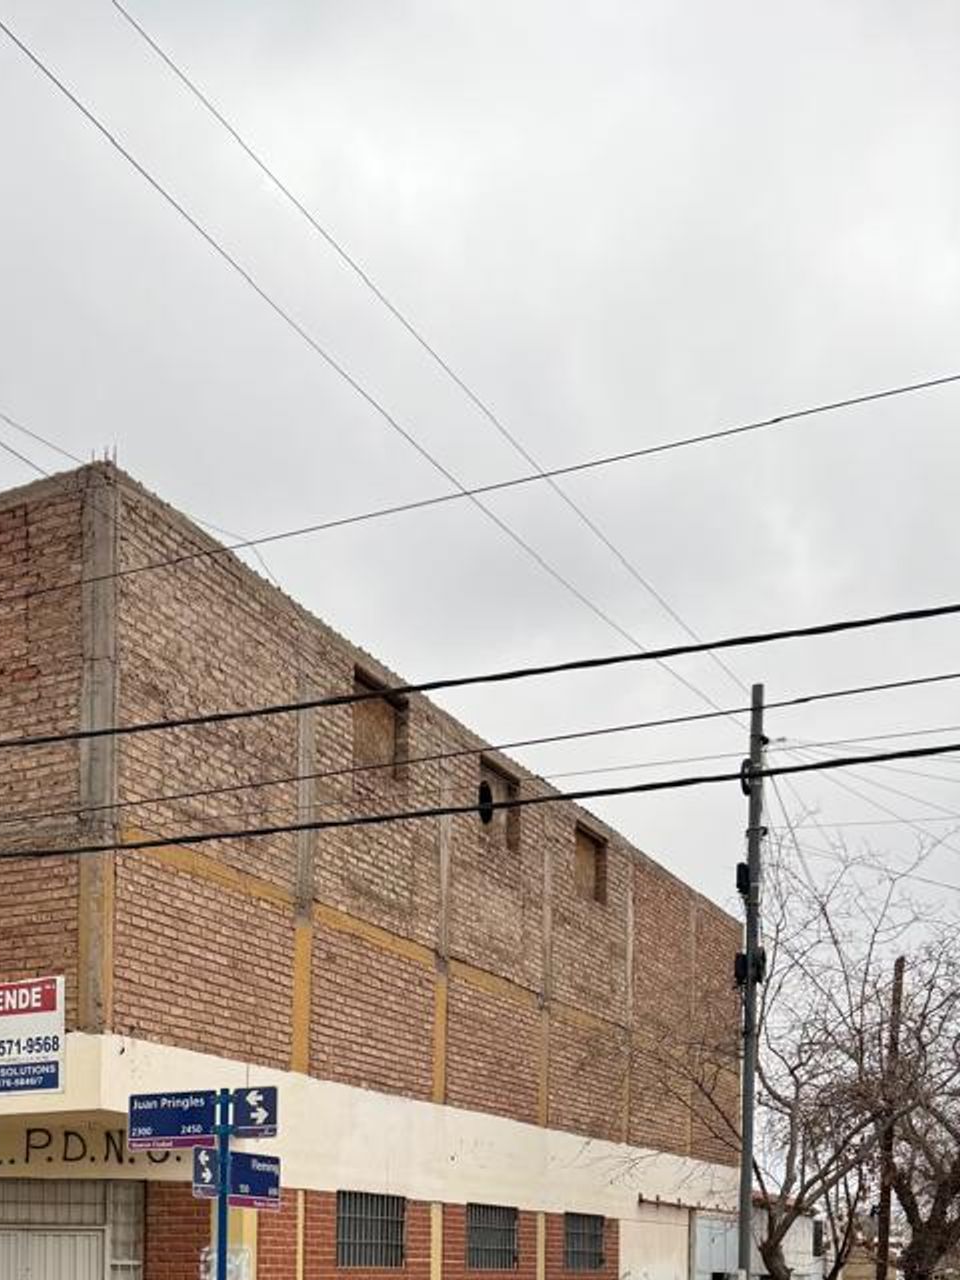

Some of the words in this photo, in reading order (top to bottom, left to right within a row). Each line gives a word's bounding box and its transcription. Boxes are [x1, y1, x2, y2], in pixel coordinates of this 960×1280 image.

[0, 1064, 56, 1077] SOLUTIONS
[132, 1099, 158, 1110] Juan
[160, 1096, 205, 1110] Pringles
